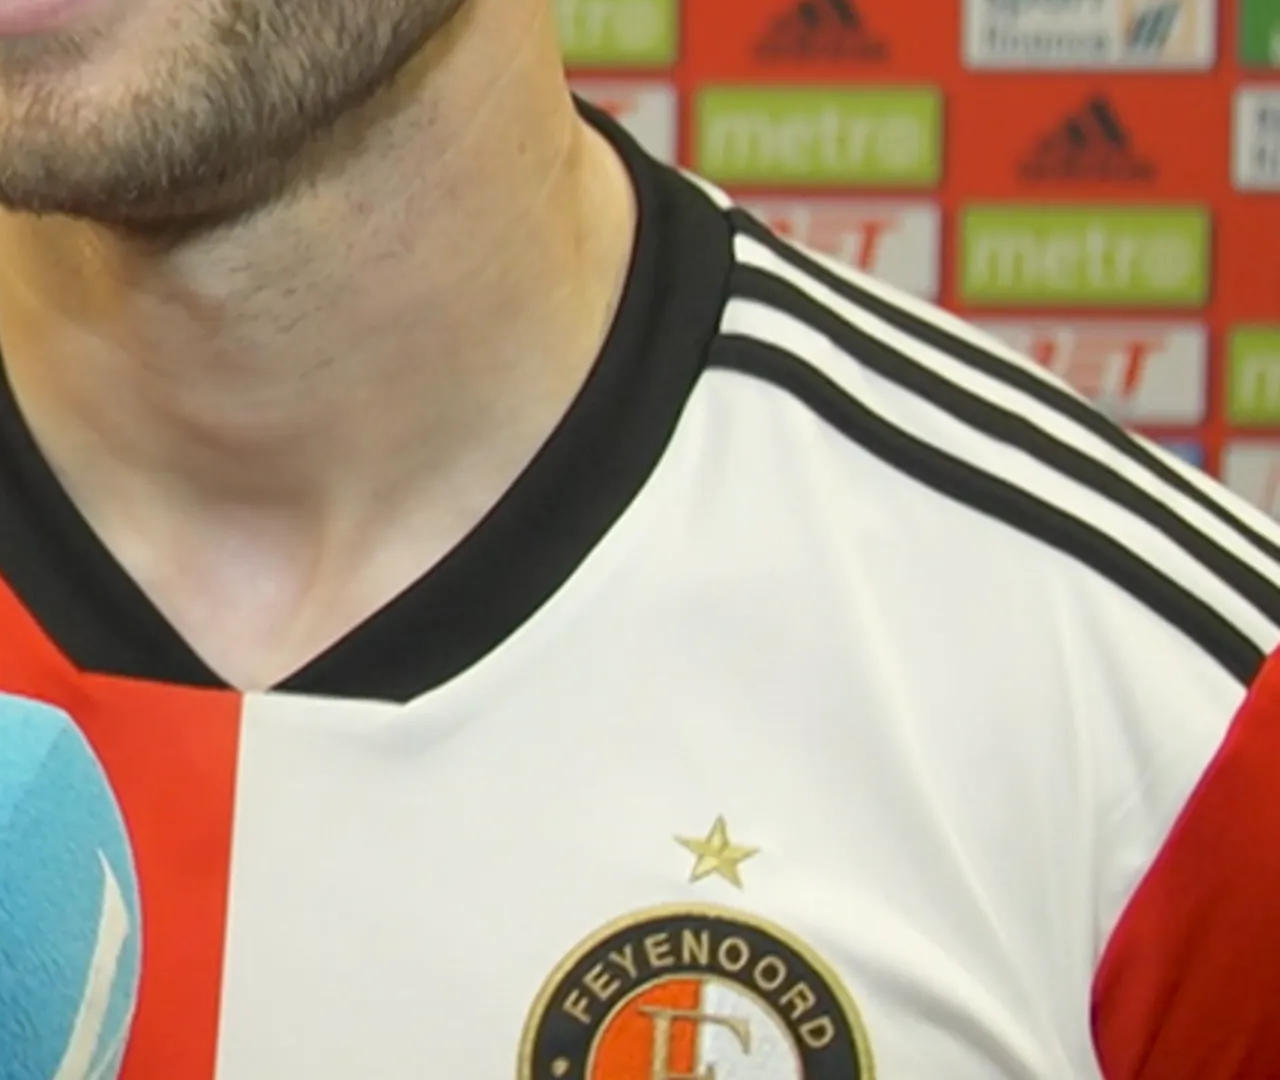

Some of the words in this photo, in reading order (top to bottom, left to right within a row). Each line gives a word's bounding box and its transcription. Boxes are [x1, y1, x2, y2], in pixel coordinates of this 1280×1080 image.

[706, 110, 925, 167] metro
[969, 228, 1193, 287] metro
[563, 929, 836, 1051] FEYENOORD
